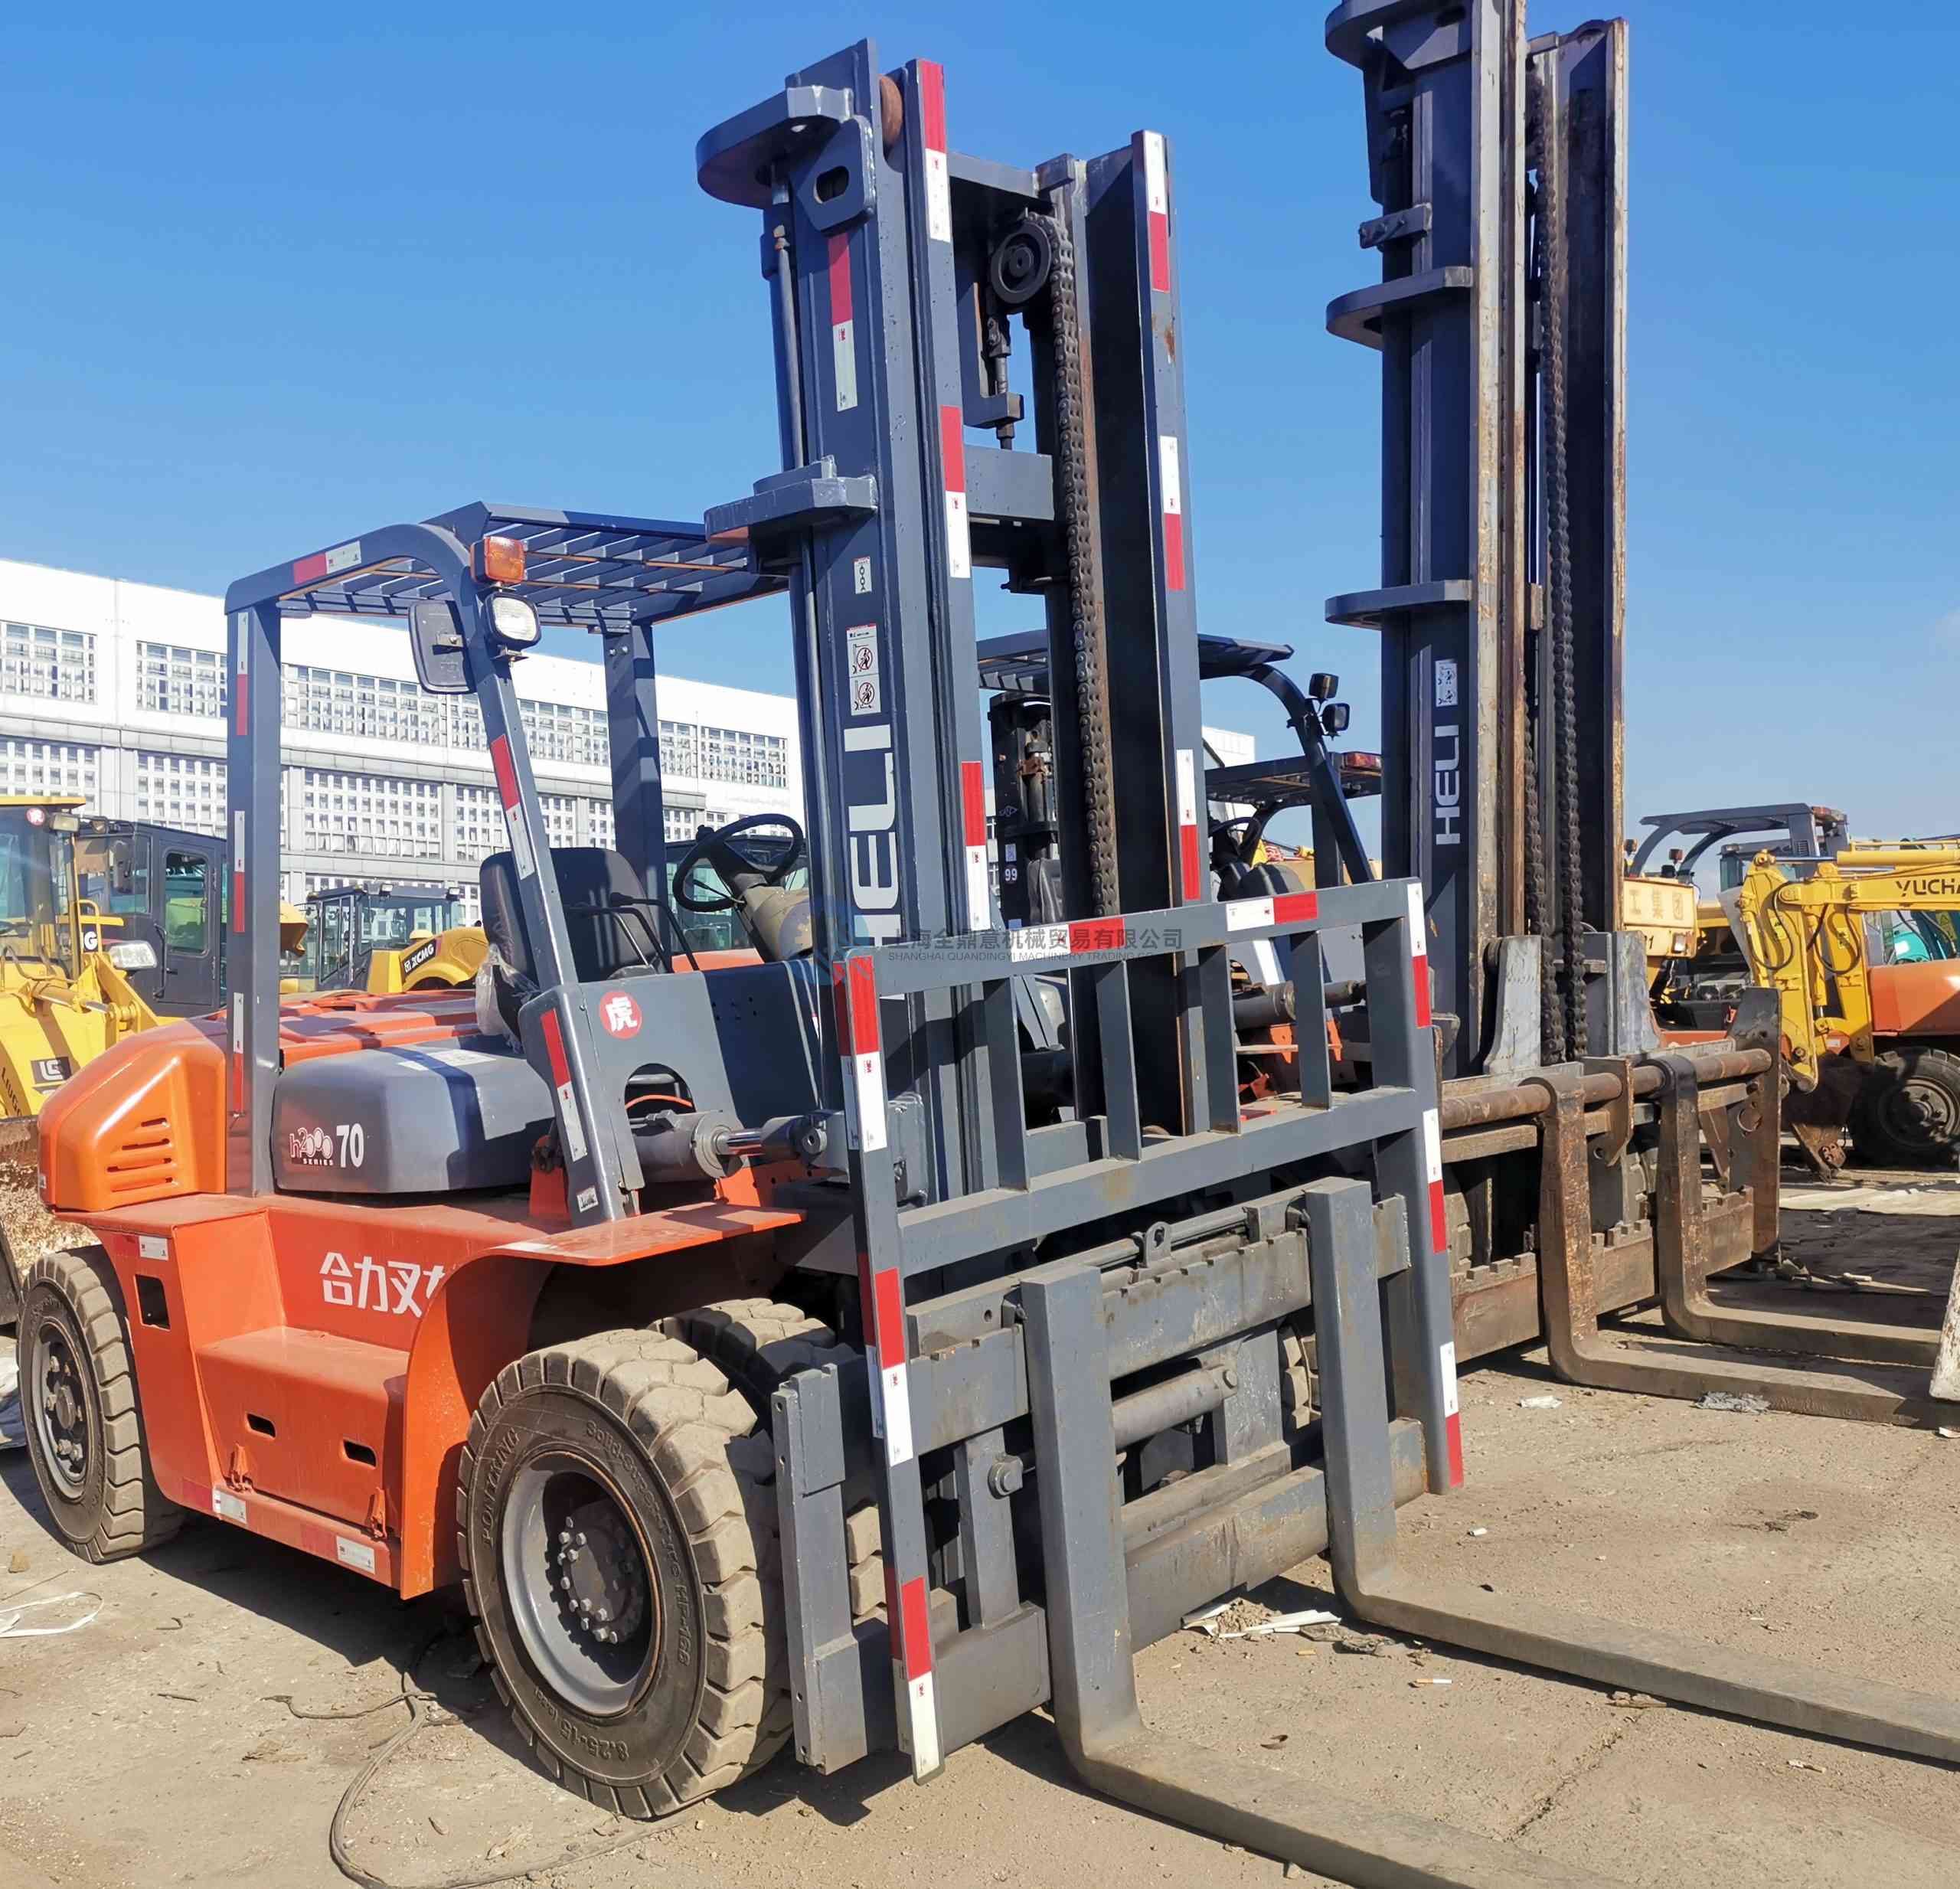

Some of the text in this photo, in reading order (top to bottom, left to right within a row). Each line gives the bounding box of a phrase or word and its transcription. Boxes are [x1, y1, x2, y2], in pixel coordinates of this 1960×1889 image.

[1434, 724, 1461, 845] HELI
[1004, 868, 1018, 881] 99
[411, 943, 435, 968] XCMG
[605, 995, 638, 1032] 虎
[336, 1123, 364, 1168] 70
[302, 1158, 334, 1166] SERIES
